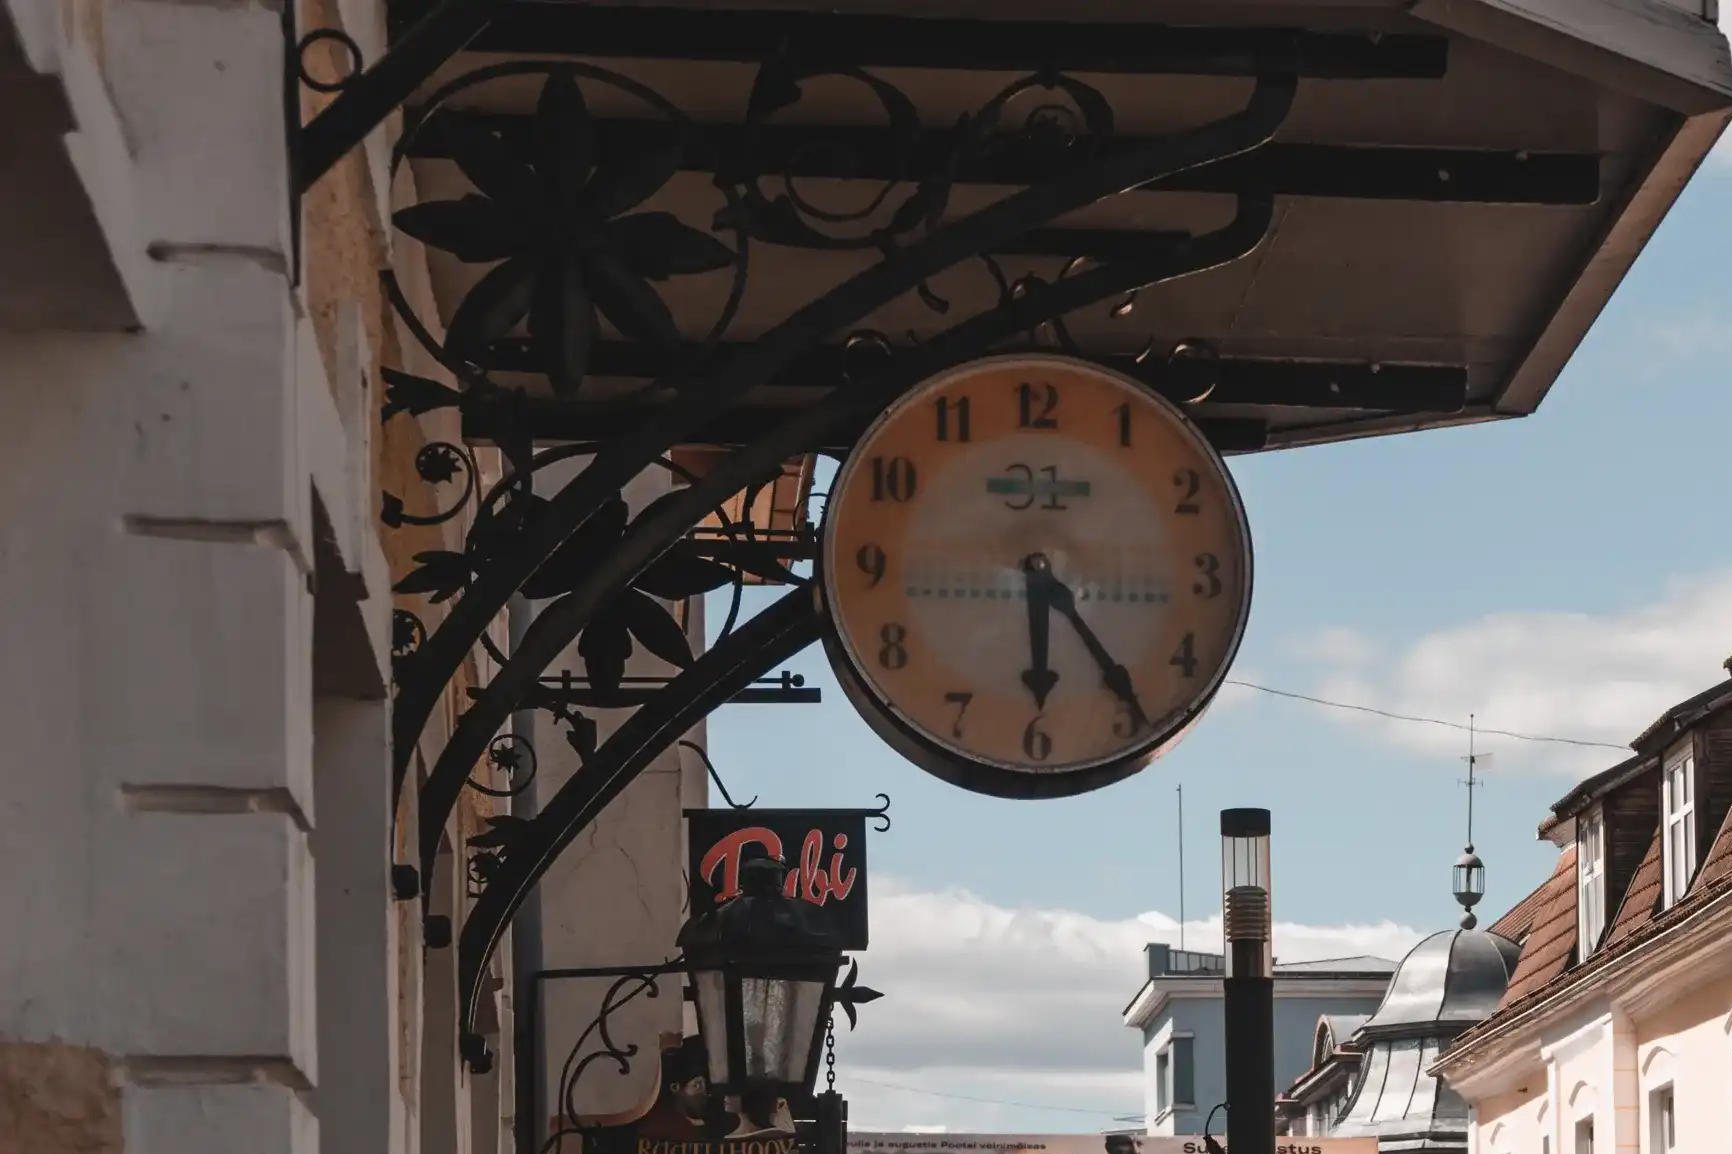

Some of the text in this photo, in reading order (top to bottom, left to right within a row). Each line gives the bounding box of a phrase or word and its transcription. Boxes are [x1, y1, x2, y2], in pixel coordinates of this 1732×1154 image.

[934, 396, 971, 442] 11
[1014, 382, 1059, 429] 12
[1111, 402, 1132, 448] 1
[869, 455, 917, 502] 10
[1172, 468, 1200, 514] 2
[855, 543, 887, 589] 9
[1193, 552, 1222, 598] 3
[878, 623, 909, 670] 8
[1170, 631, 1198, 678] 4
[944, 692, 974, 739] 7
[1023, 716, 1052, 761] 6
